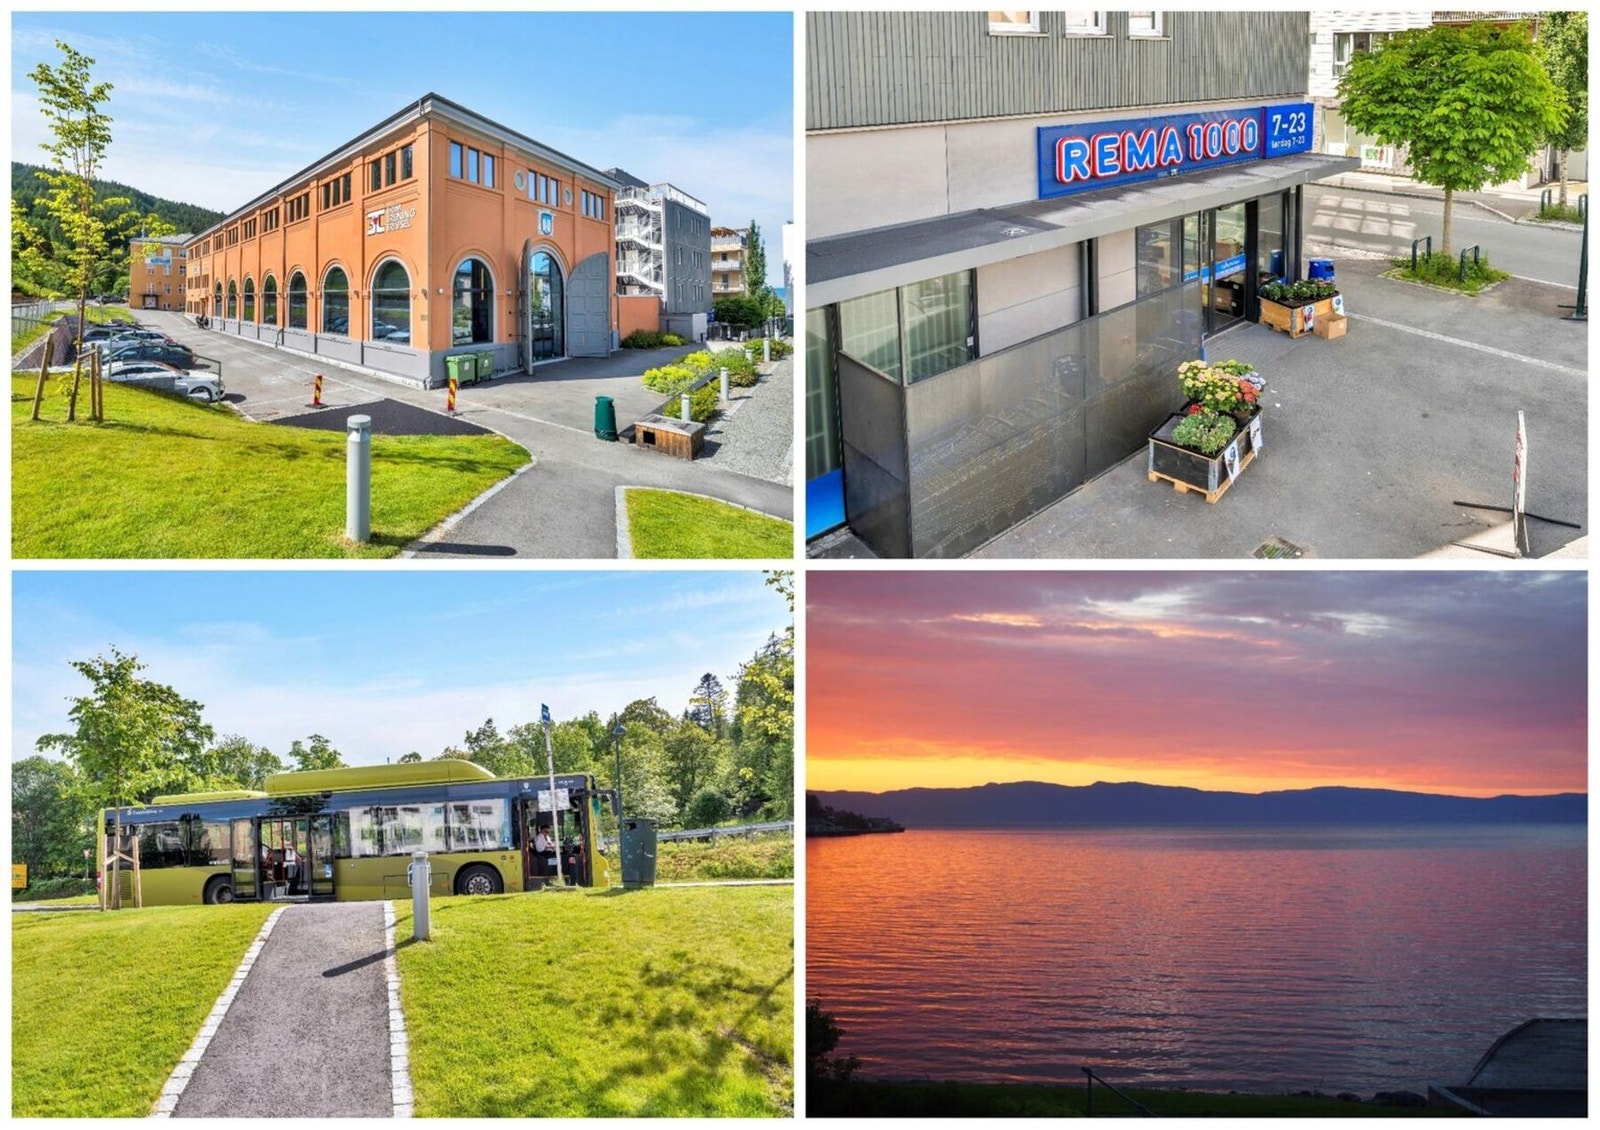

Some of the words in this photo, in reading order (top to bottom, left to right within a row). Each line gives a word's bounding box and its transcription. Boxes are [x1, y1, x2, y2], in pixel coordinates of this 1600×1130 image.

[1272, 111, 1306, 136] 7-23
[1056, 126, 1183, 183] REMA
[1187, 117, 1258, 161] 1000
